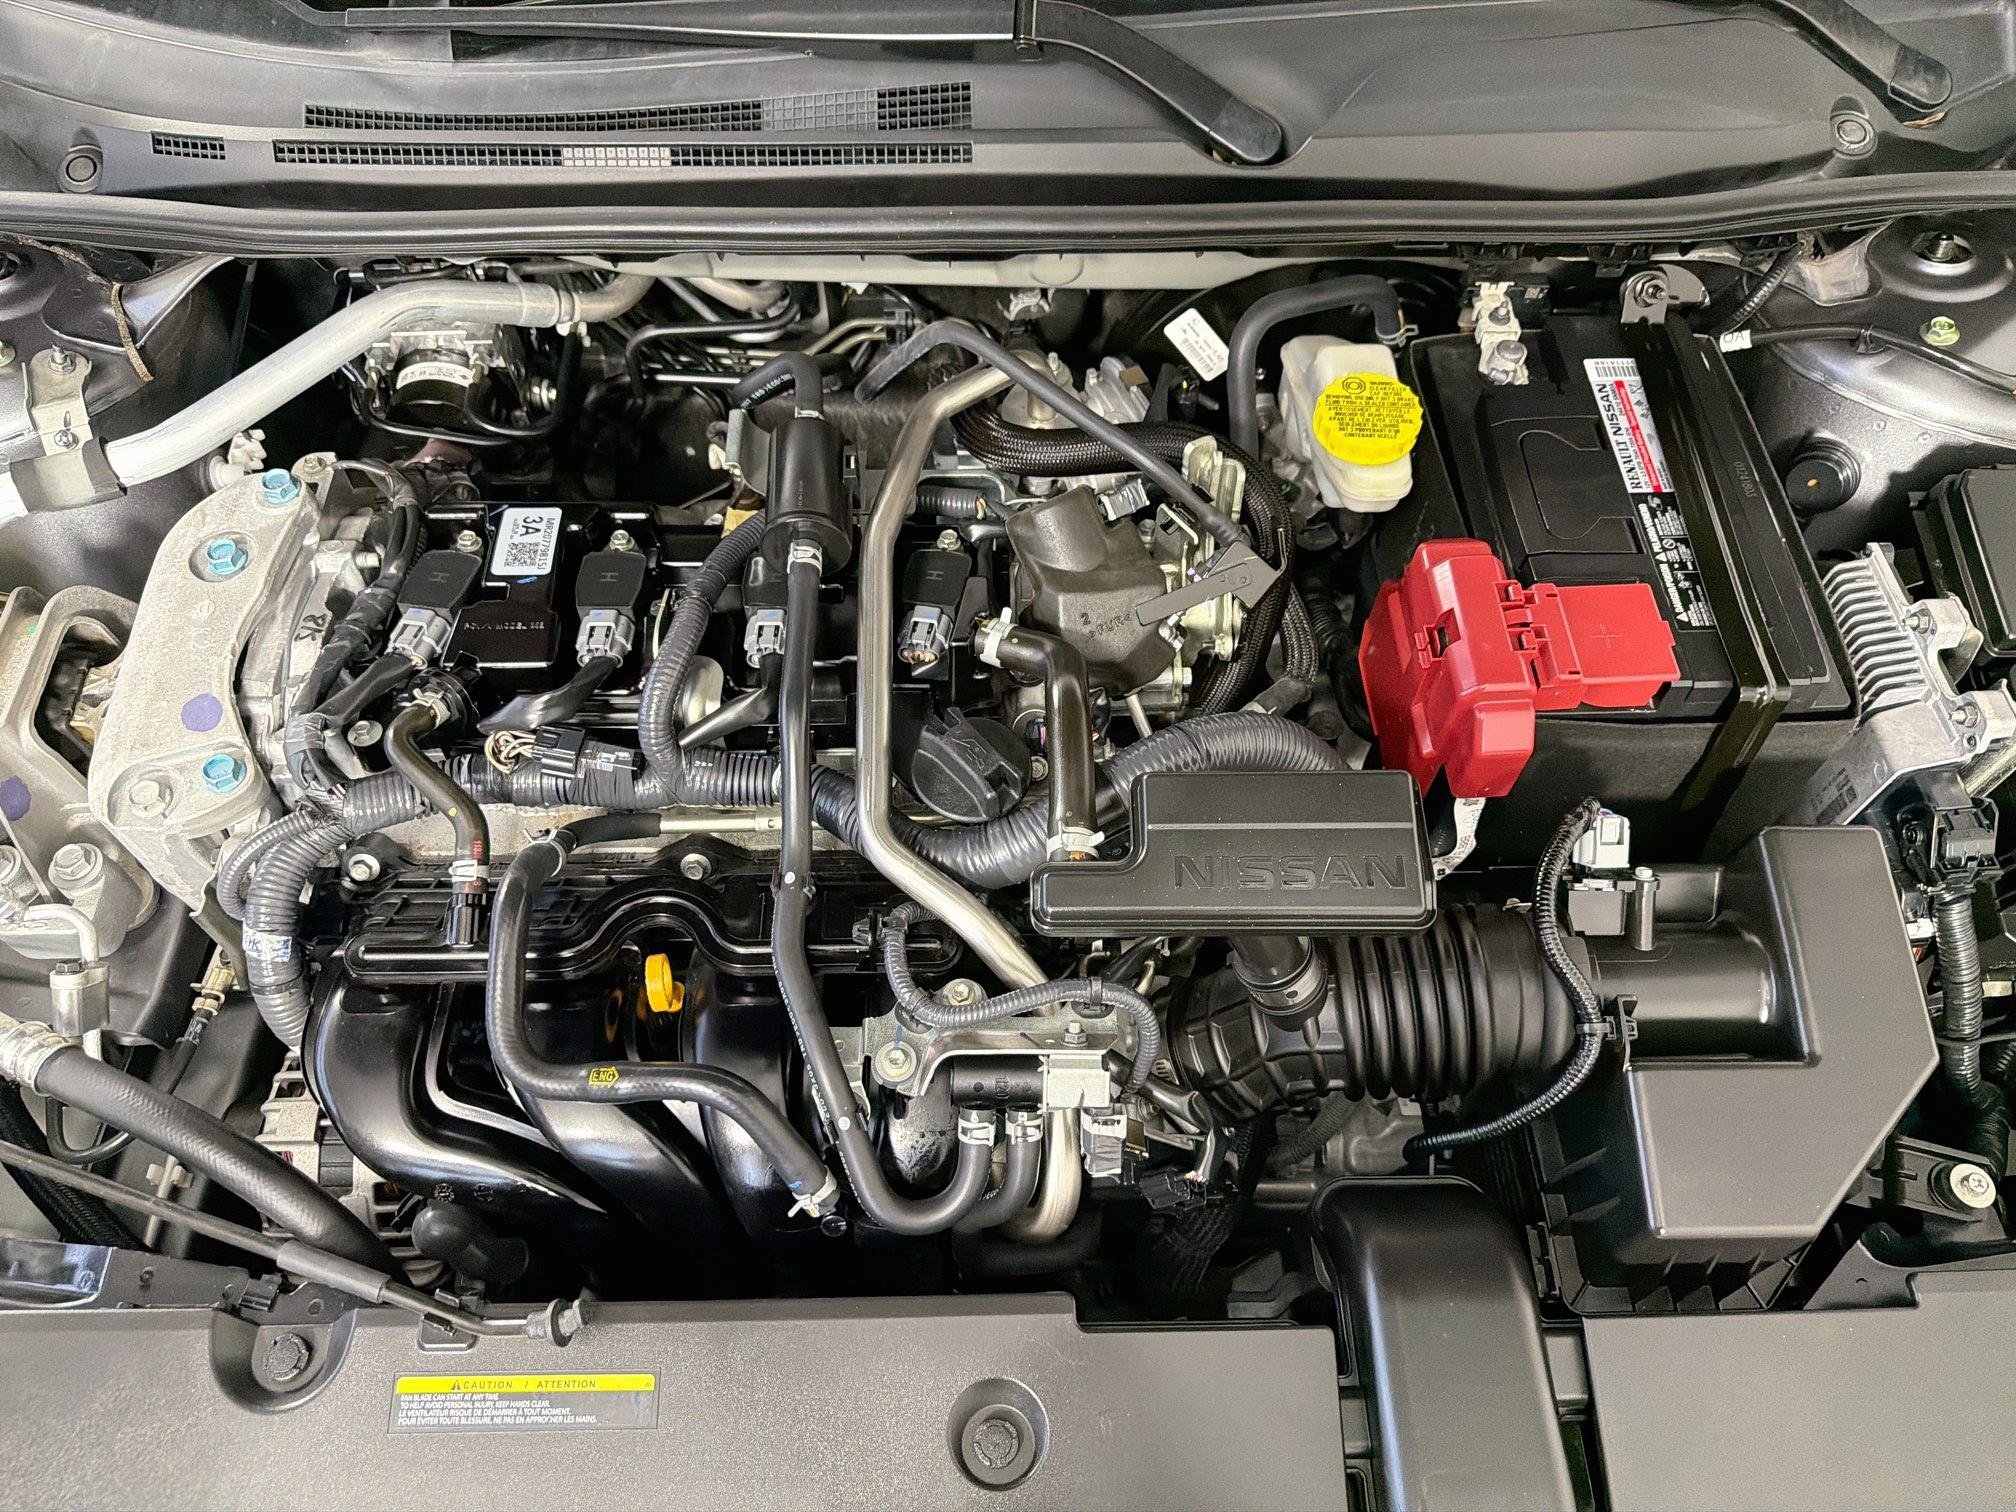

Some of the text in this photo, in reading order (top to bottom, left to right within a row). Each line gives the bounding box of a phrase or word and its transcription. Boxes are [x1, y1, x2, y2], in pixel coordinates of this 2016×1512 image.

[1595, 383, 1624, 437] NISSAN
[1616, 439, 1643, 490] RENAULT
[519, 516, 544, 538] 3A
[1173, 854, 1408, 891] NISSAN
[463, 1380, 513, 1390] CAUTION
[537, 1379, 596, 1389] ATTENTION
[413, 1393, 432, 1401] BLADE
[400, 1401, 410, 1409] TO
[407, 1409, 448, 1417] VENTILATEUR
[449, 1409, 472, 1417] RISQUE
[398, 1417, 417, 1425] POUR
[564, 1415, 575, 1423] LES
